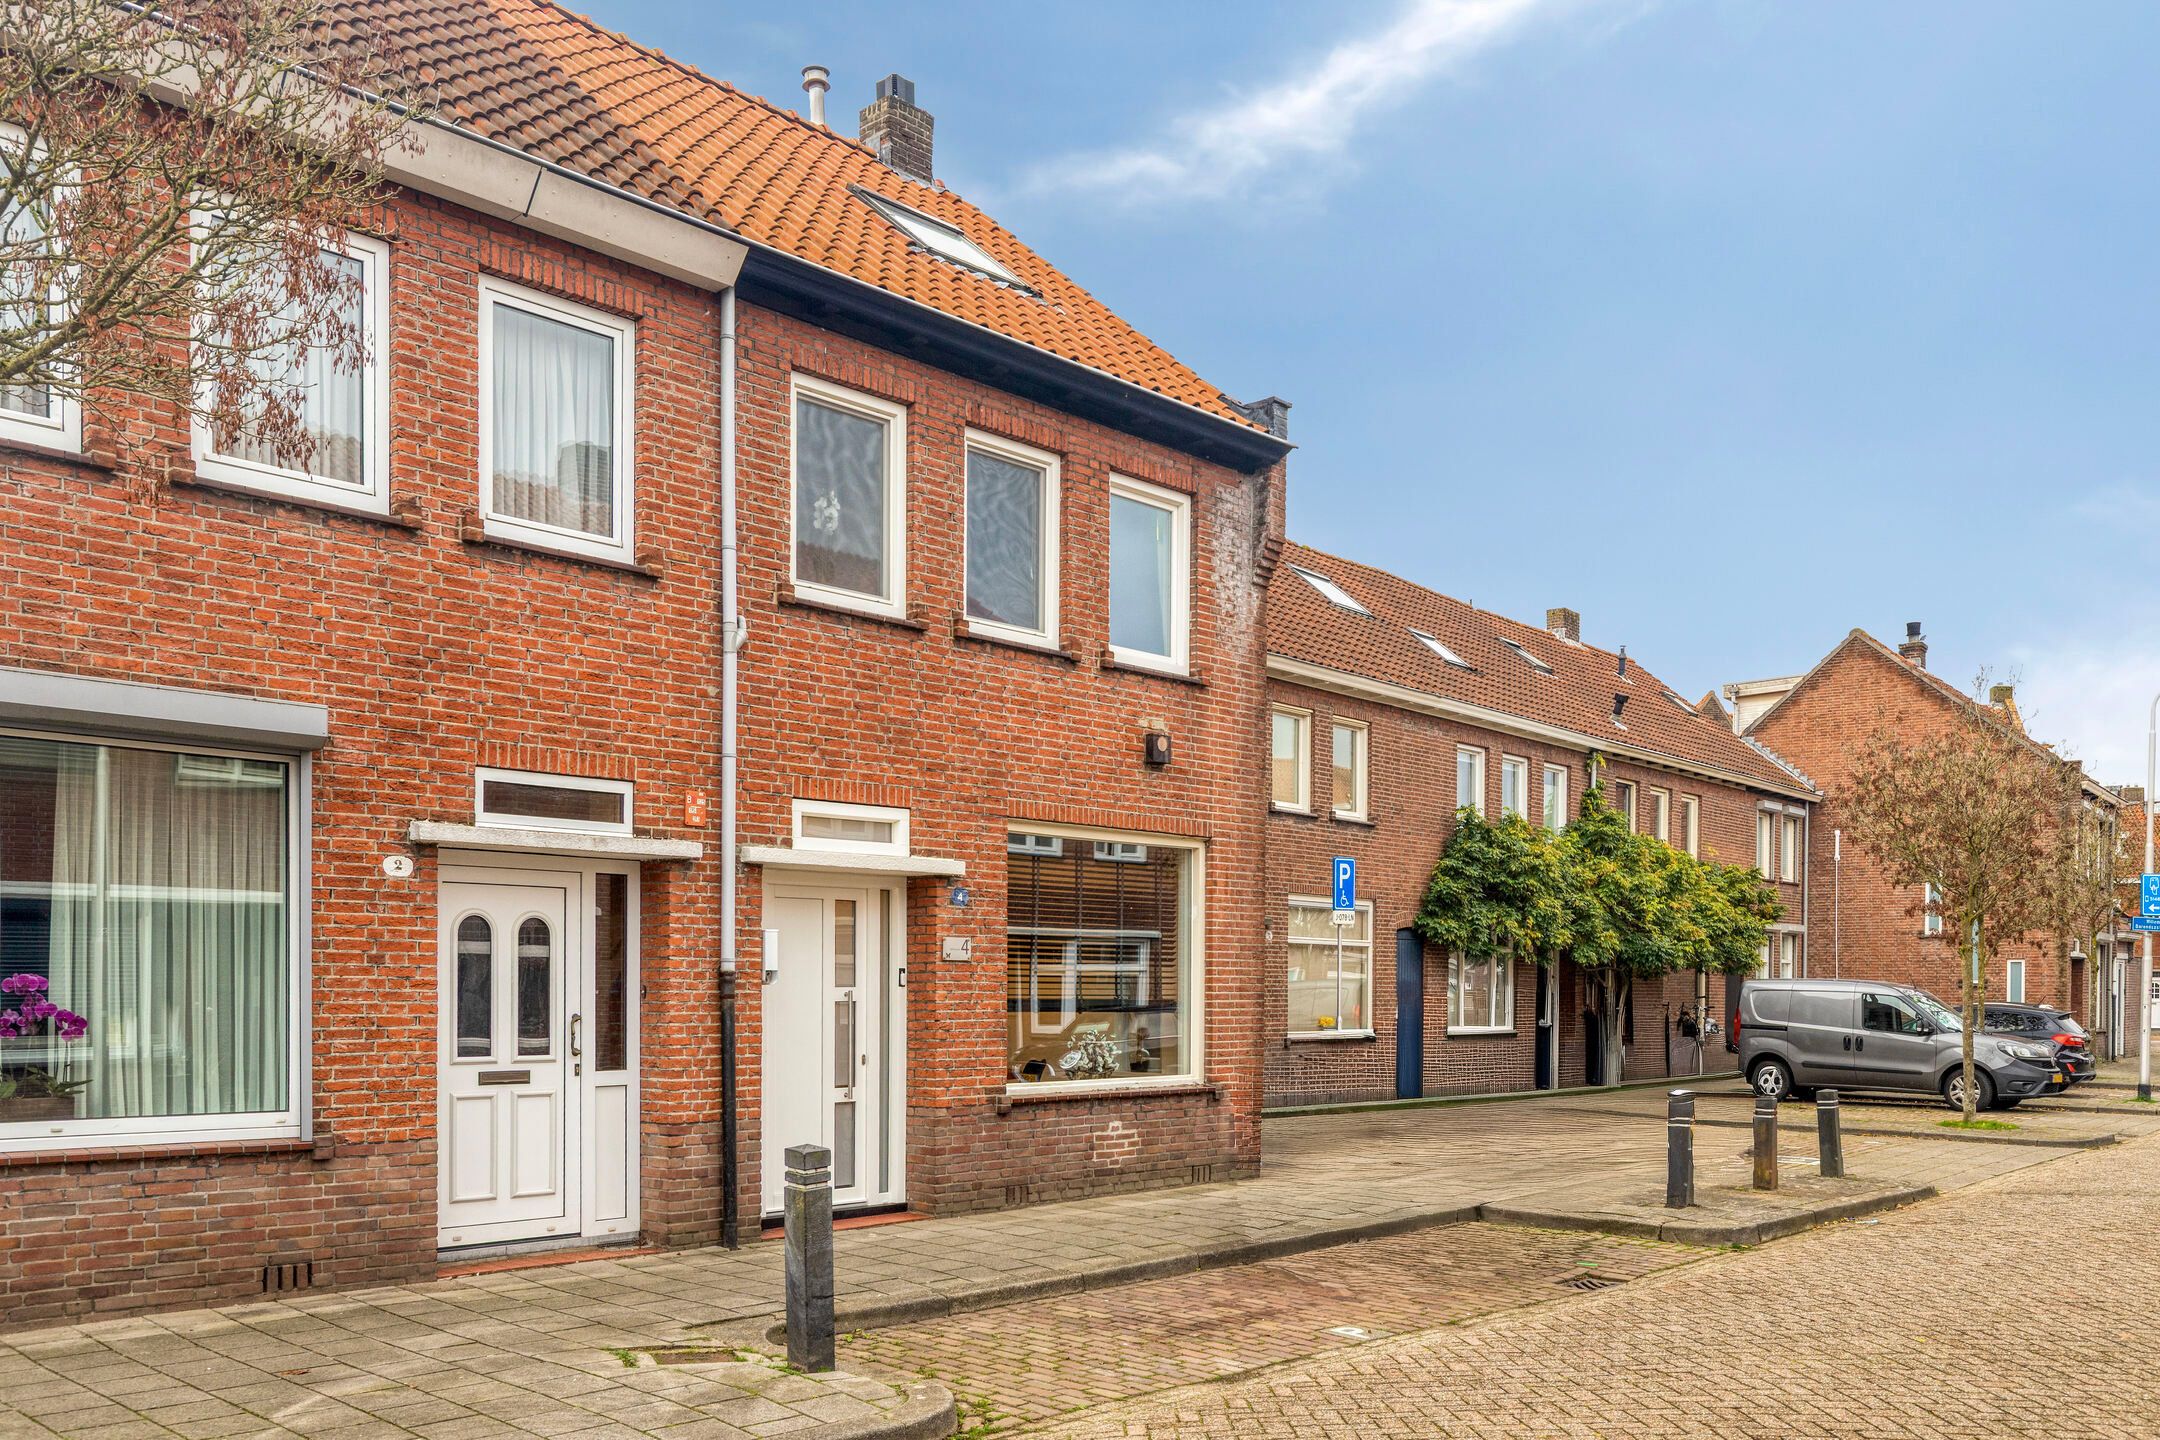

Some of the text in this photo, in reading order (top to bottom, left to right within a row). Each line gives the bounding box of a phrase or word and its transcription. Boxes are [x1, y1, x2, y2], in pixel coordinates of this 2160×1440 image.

[393, 859, 403, 871] 2
[1339, 863, 1351, 889] P
[957, 892, 963, 902] 4
[960, 939, 970, 955] 4
[1330, 1327, 1371, 1340] P
